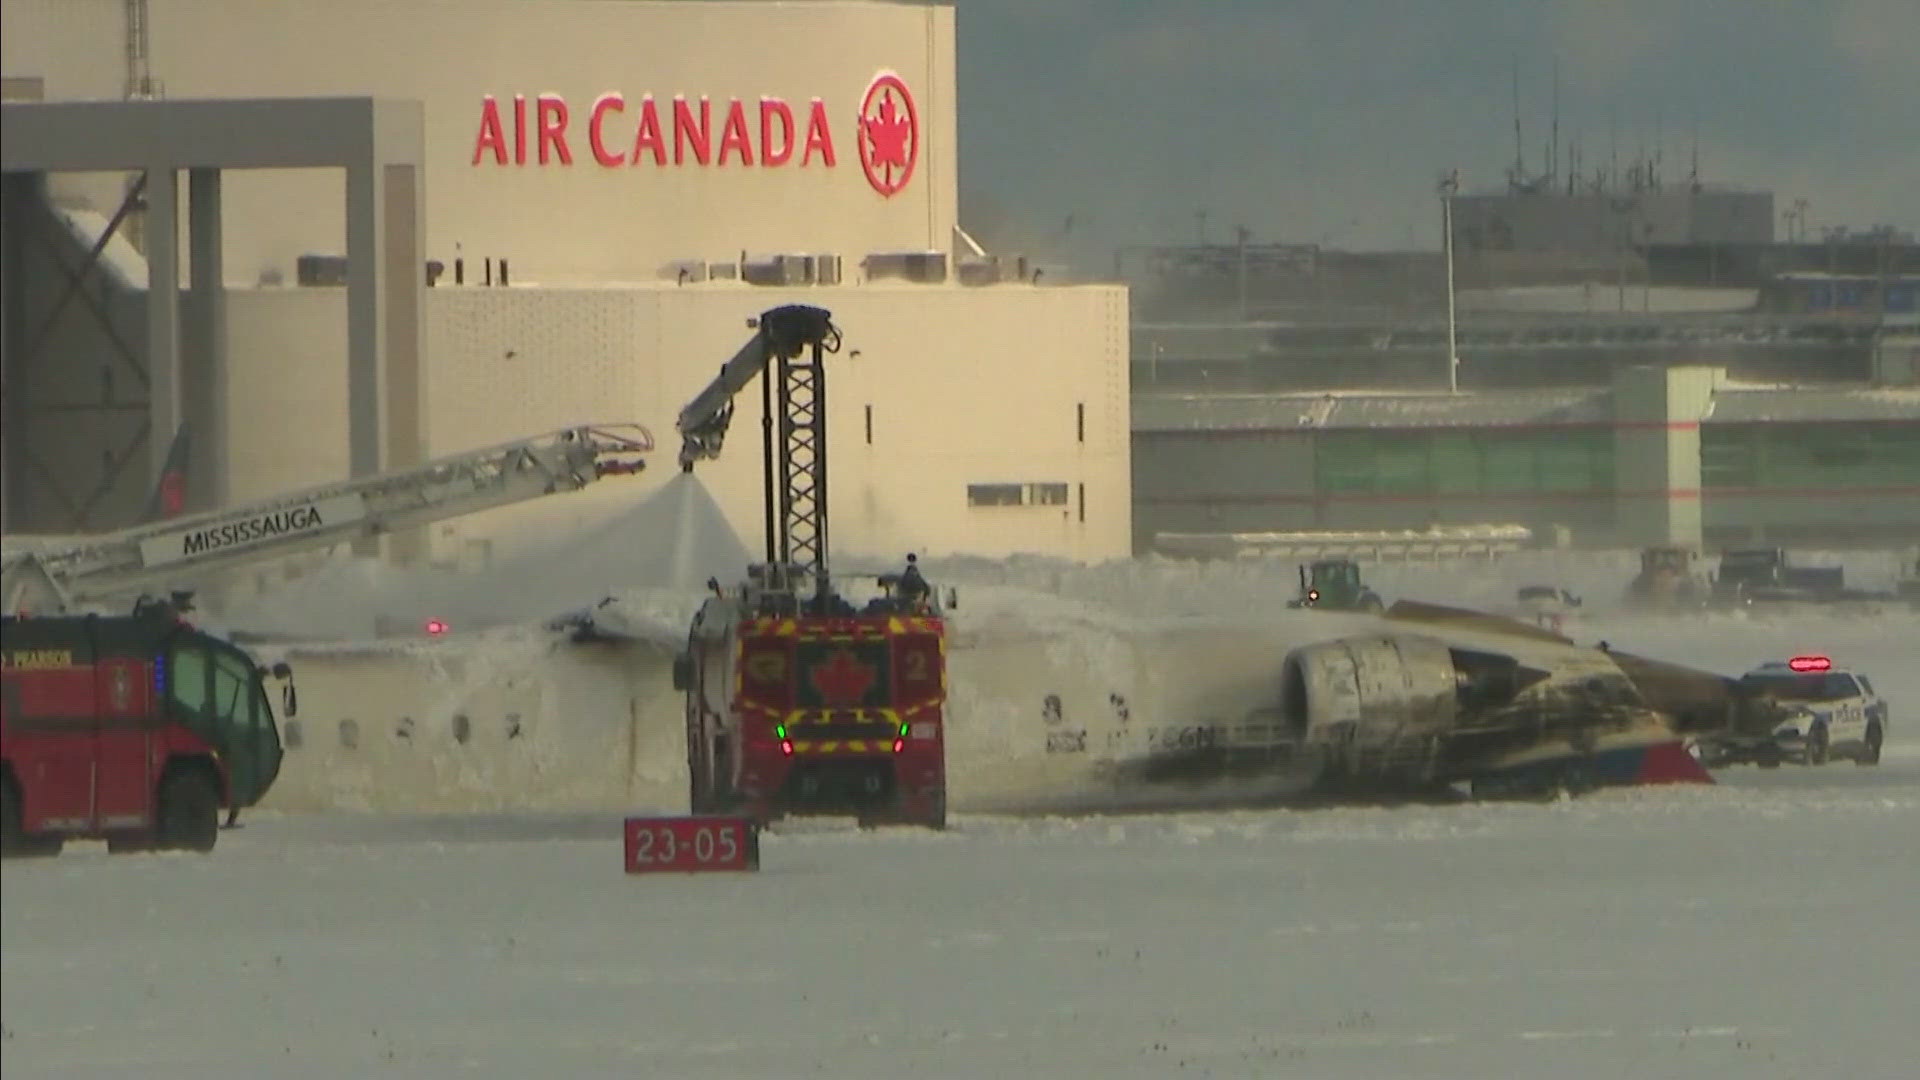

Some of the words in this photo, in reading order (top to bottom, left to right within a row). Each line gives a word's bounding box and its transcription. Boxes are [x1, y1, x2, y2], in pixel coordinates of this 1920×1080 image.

[472, 93, 572, 166] AIR
[589, 92, 836, 167] CANADA
[184, 506, 323, 555] MISSISSAUGA
[906, 652, 928, 681] 2
[636, 827, 737, 863] 23-05
